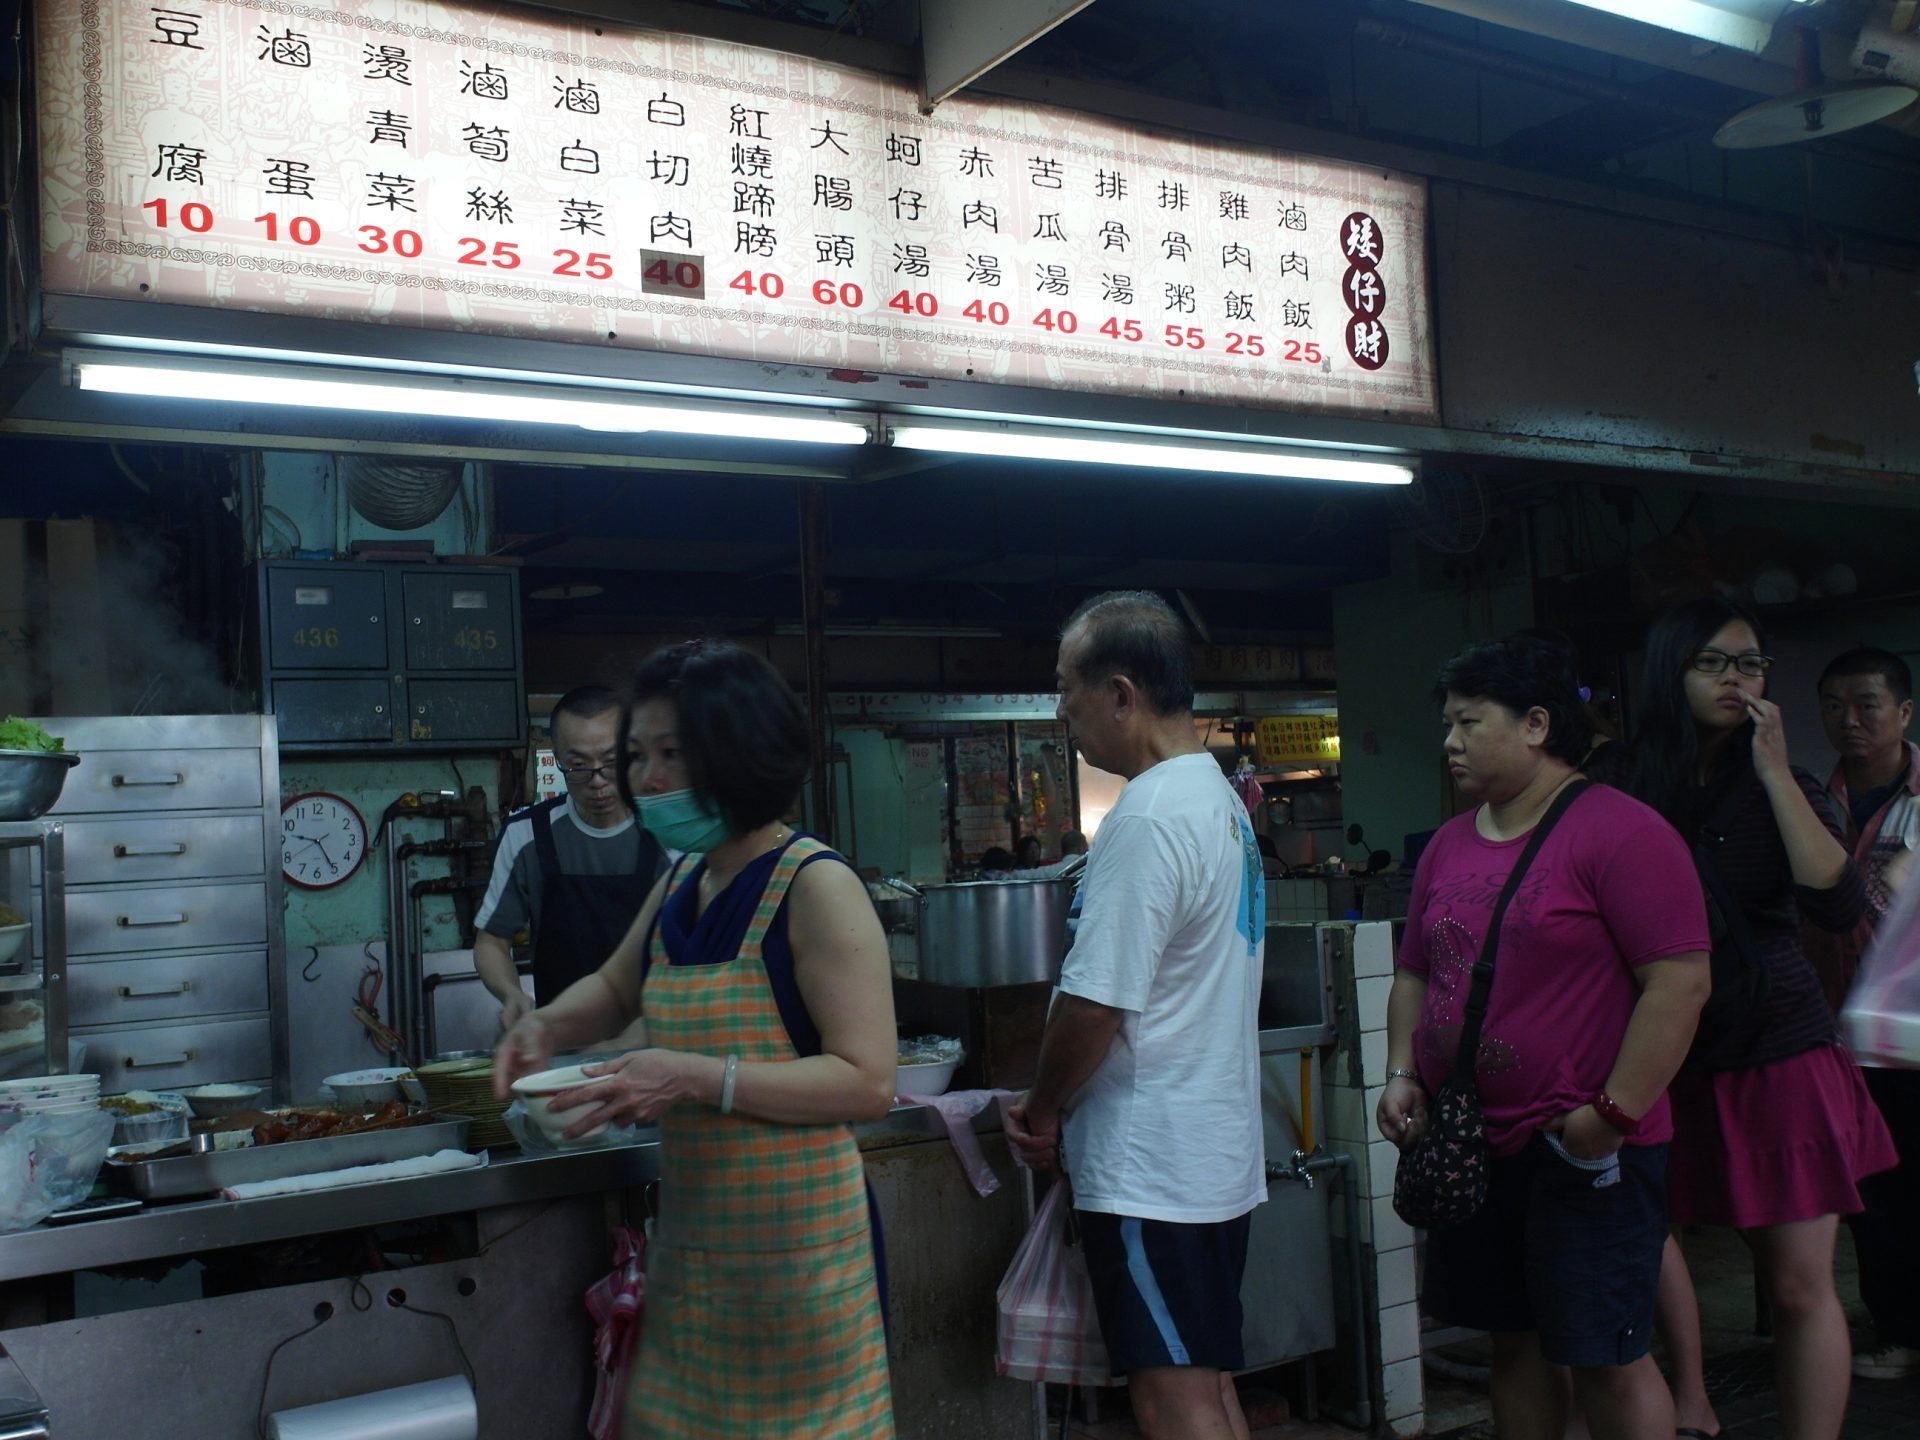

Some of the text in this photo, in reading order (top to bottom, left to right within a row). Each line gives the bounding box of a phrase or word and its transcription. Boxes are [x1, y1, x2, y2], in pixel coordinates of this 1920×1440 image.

[149, 7, 207, 186] 豆腐
[257, 24, 316, 200] 滷蛋
[363, 43, 417, 213] 燙青菜
[459, 59, 513, 225] 滷筍絲
[552, 75, 605, 236] 滷白菜
[645, 91, 693, 248] 白切肉
[729, 103, 777, 257] 紅燒蹄膀
[810, 119, 855, 268] 大腸頭
[143, 198, 214, 233] 10
[885, 132, 930, 277] 蚵仔湯
[959, 146, 1002, 287] 赤肉湯
[255, 212, 321, 246] 10
[1028, 156, 1069, 296] 苦瓜湯
[1095, 168, 1133, 305] 排骨湯
[358, 225, 423, 259] 30
[458, 237, 521, 270] 25
[1158, 180, 1195, 314] 排骨粥
[1219, 190, 1256, 322] 雞肉飯
[553, 249, 613, 280] 25
[644, 258, 701, 289] 40
[1277, 200, 1313, 330] 滷肉飯
[730, 270, 785, 299] 40
[812, 279, 863, 308] 60
[1346, 217, 1382, 363] 矮仔財
[888, 290, 939, 317] 40
[962, 299, 1010, 326] 40
[1032, 308, 1078, 334] 40
[1099, 316, 1143, 342] 45
[1165, 324, 1205, 350] 55
[1225, 332, 1265, 357] 25
[1284, 339, 1322, 364] 25
[293, 627, 339, 648] 436
[454, 630, 497, 650] 435
[296, 807, 305, 819] 11
[312, 803, 324, 815] 12
[343, 818, 350, 830] 2
[284, 820, 295, 831] 10
[348, 834, 356, 846] 3
[284, 851, 291, 863] 8
[299, 863, 307, 875] 7
[330, 863, 338, 874] 5
[343, 851, 350, 860] 4
[313, 867, 321, 879] 6
